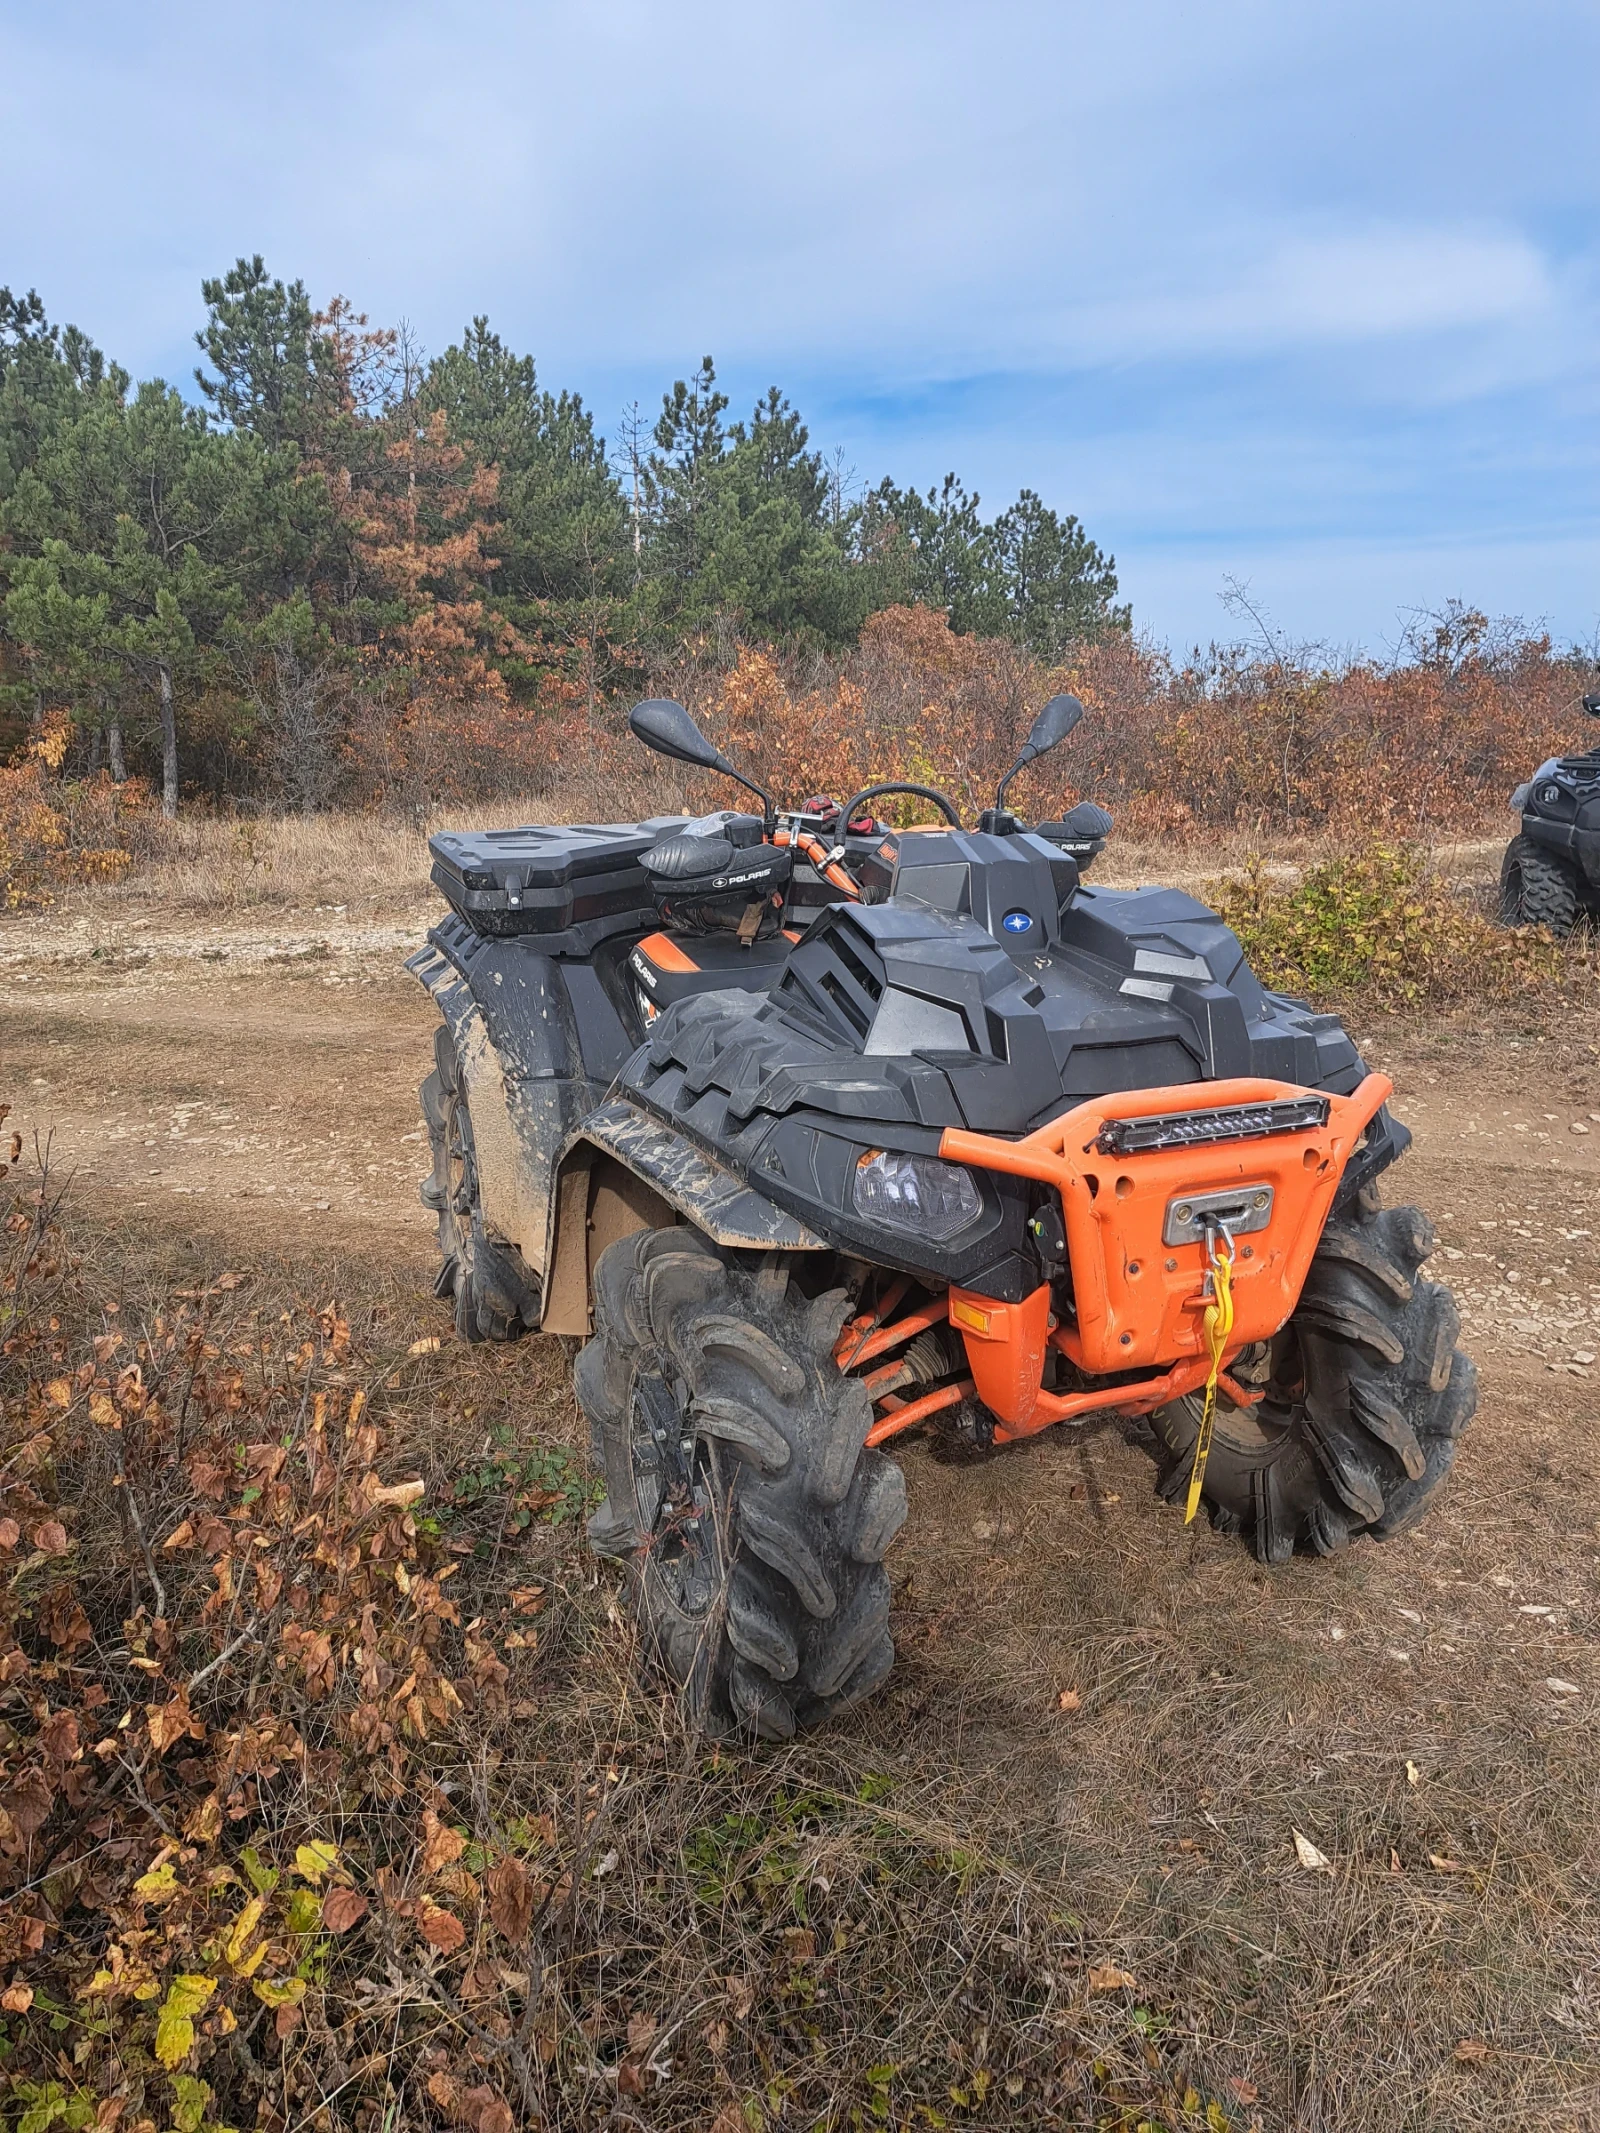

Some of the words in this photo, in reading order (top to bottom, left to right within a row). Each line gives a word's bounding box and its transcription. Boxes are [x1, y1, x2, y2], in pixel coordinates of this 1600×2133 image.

[1061, 843, 1091, 851] POLARIS
[729, 868, 771, 885] POLARIS
[632, 953, 657, 988] POLARIS
